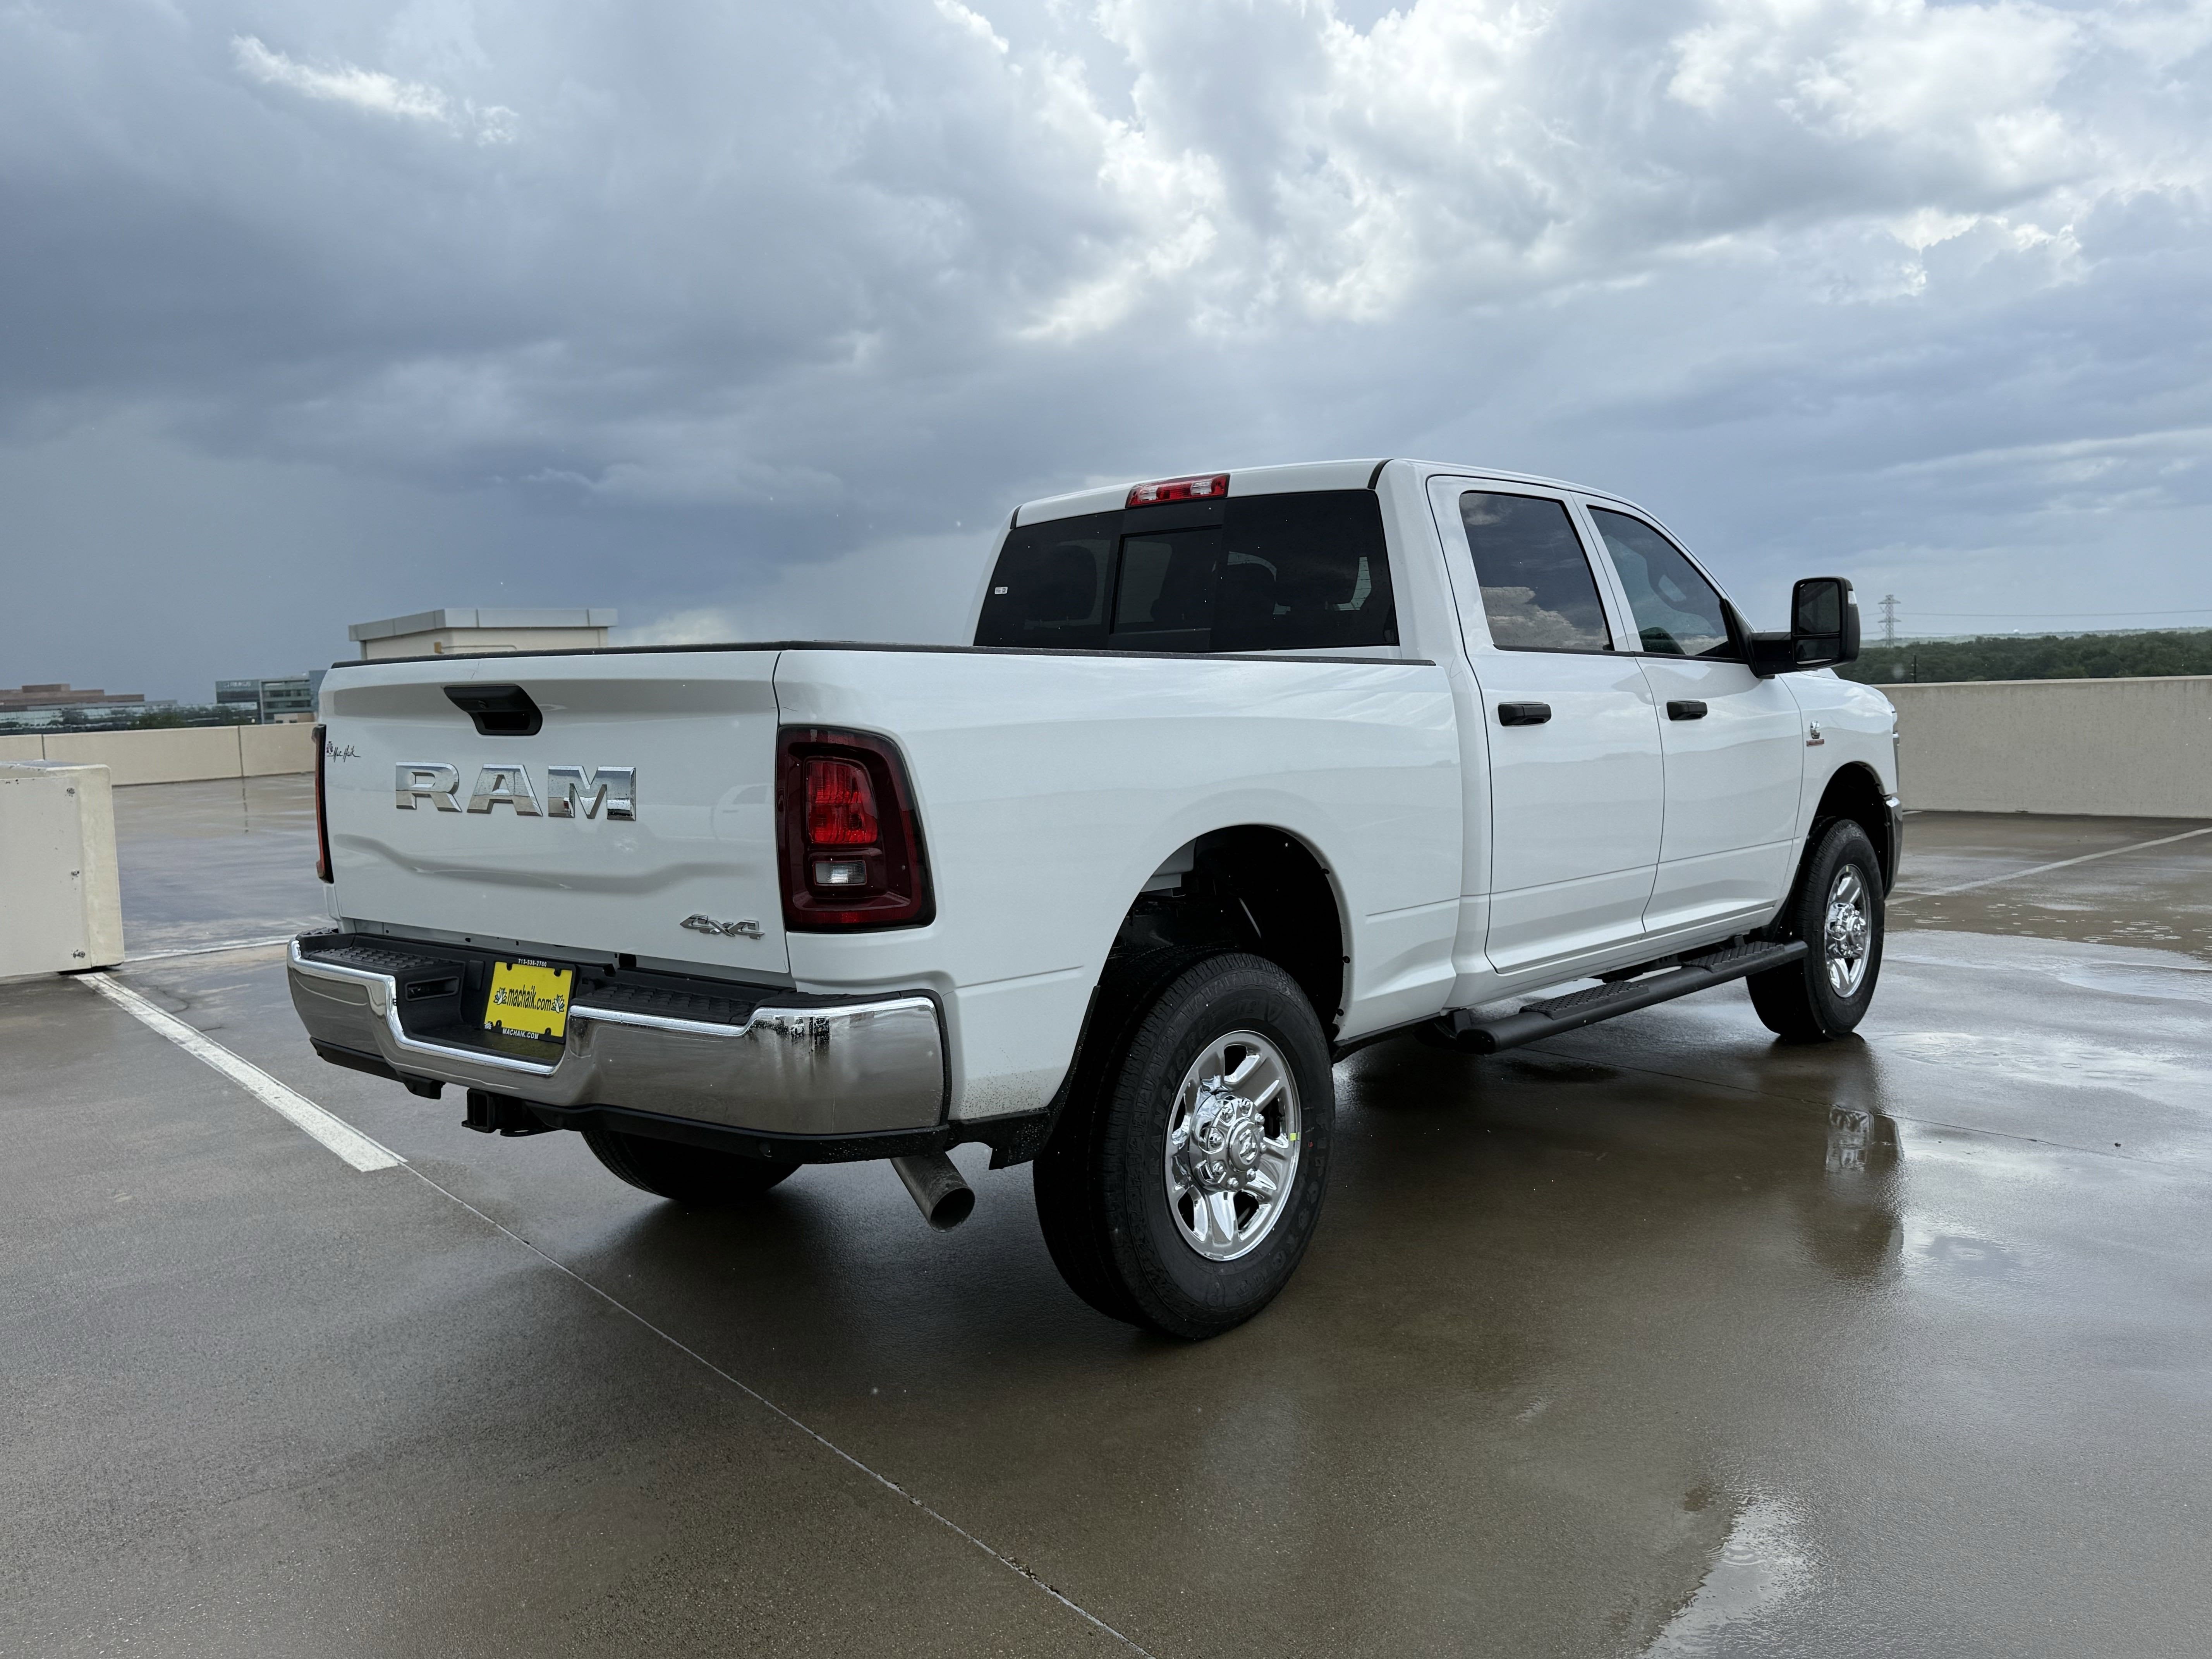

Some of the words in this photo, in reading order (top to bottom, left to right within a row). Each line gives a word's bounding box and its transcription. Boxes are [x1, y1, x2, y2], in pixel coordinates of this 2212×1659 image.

[395, 761, 636, 821] RAM
[507, 984, 551, 1012] machaik.com
[502, 1028, 539, 1039] MACHAIK.COM
